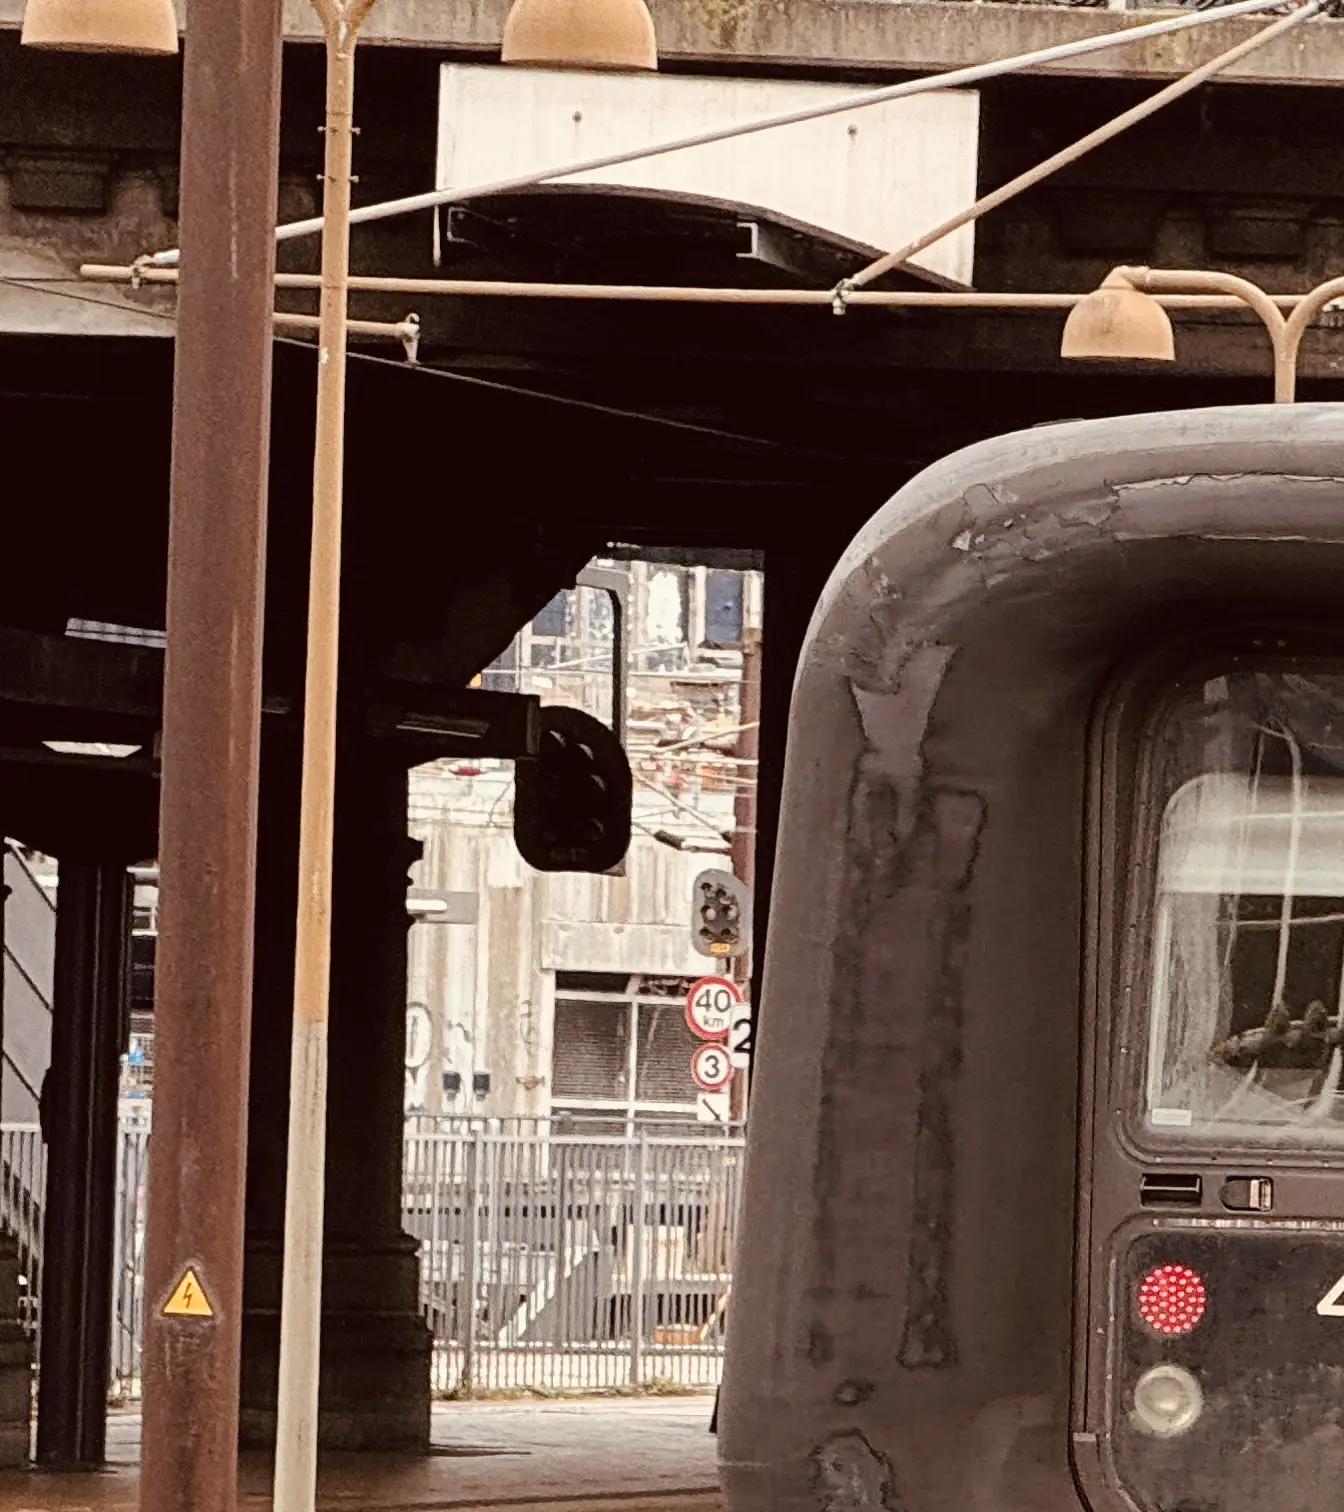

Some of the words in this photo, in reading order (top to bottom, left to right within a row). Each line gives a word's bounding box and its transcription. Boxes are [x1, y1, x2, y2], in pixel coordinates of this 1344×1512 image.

[695, 989, 732, 1013] 40
[703, 1013, 725, 1028] km
[704, 1055, 721, 1079] 3
